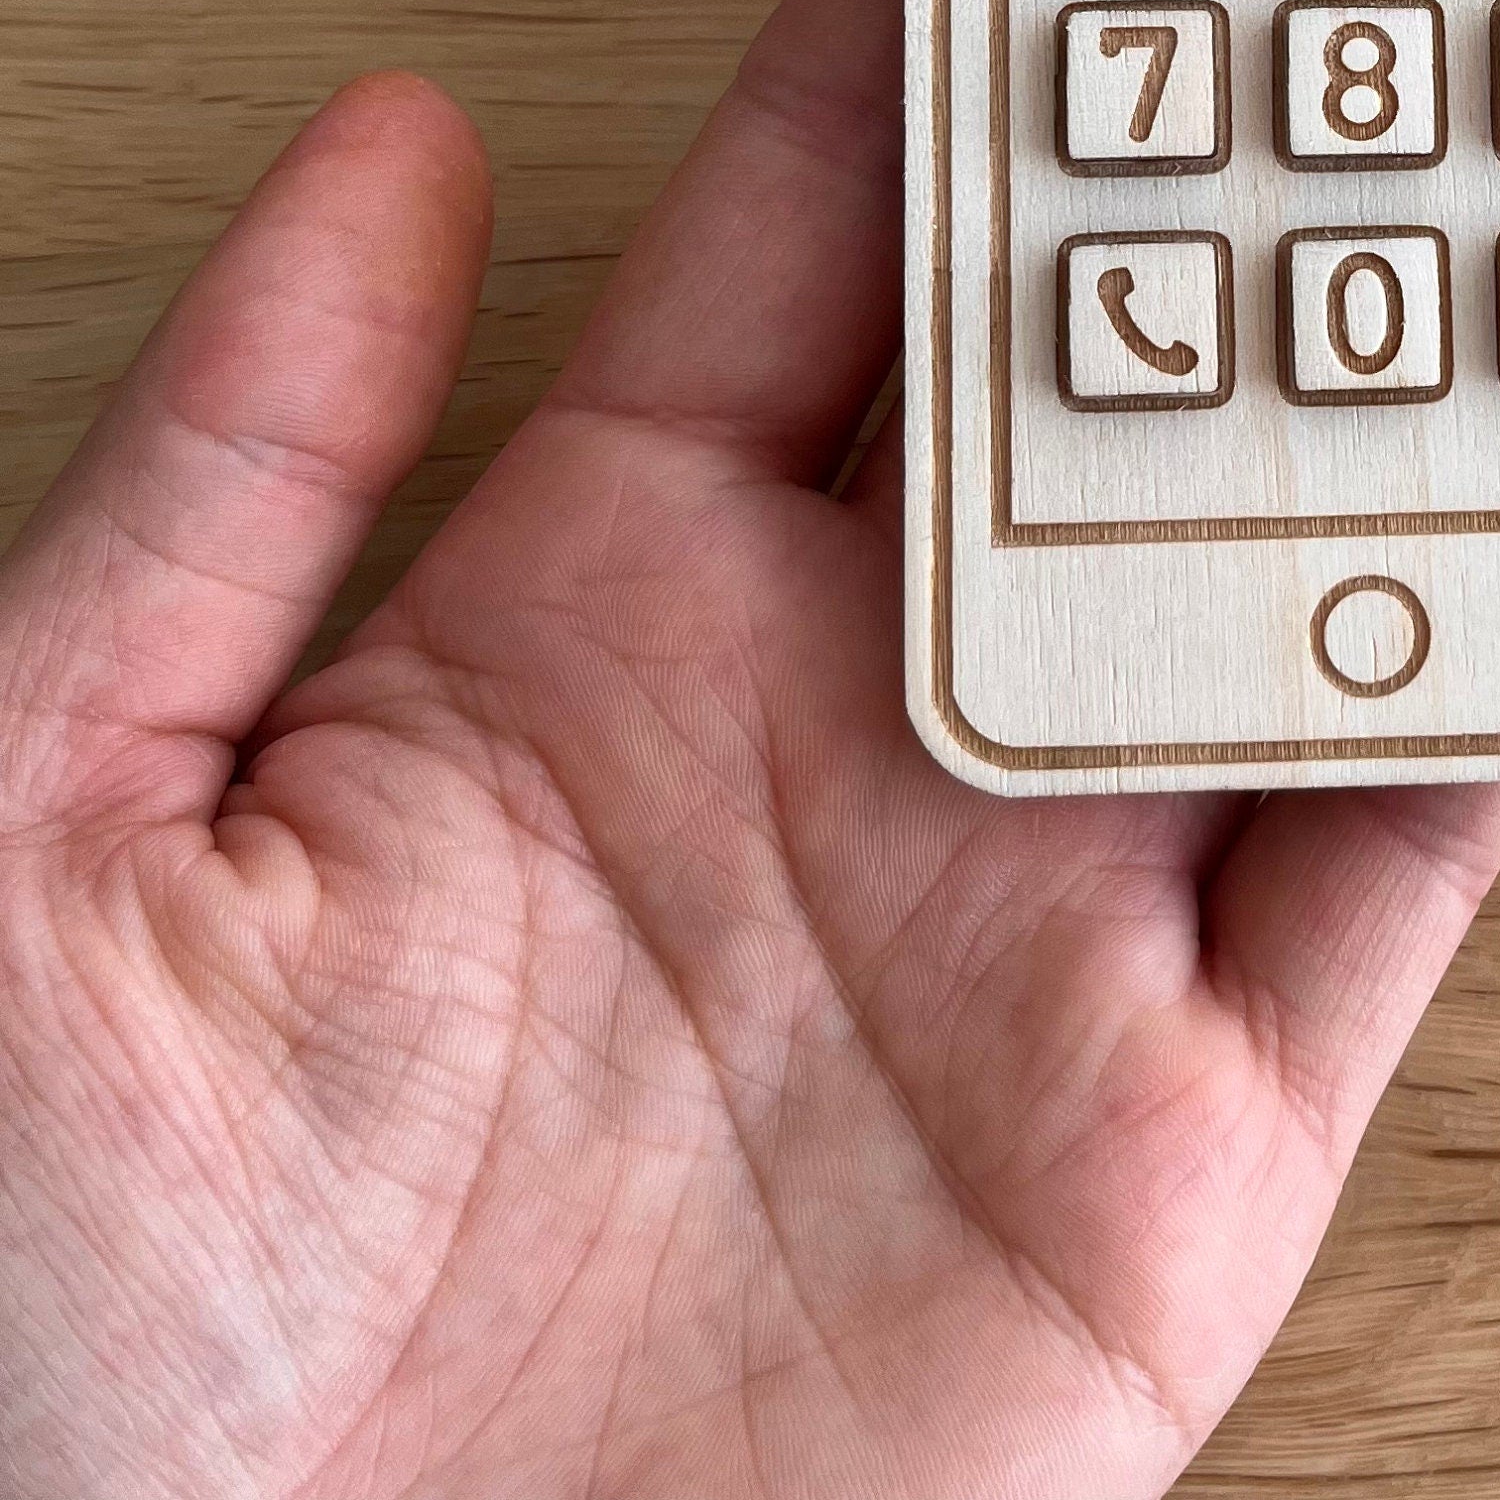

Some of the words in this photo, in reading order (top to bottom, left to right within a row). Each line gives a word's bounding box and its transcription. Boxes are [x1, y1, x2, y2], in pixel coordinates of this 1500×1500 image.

[1099, 25, 1179, 143] 7
[1321, 20, 1400, 142] 8
[1326, 251, 1406, 377] 0
